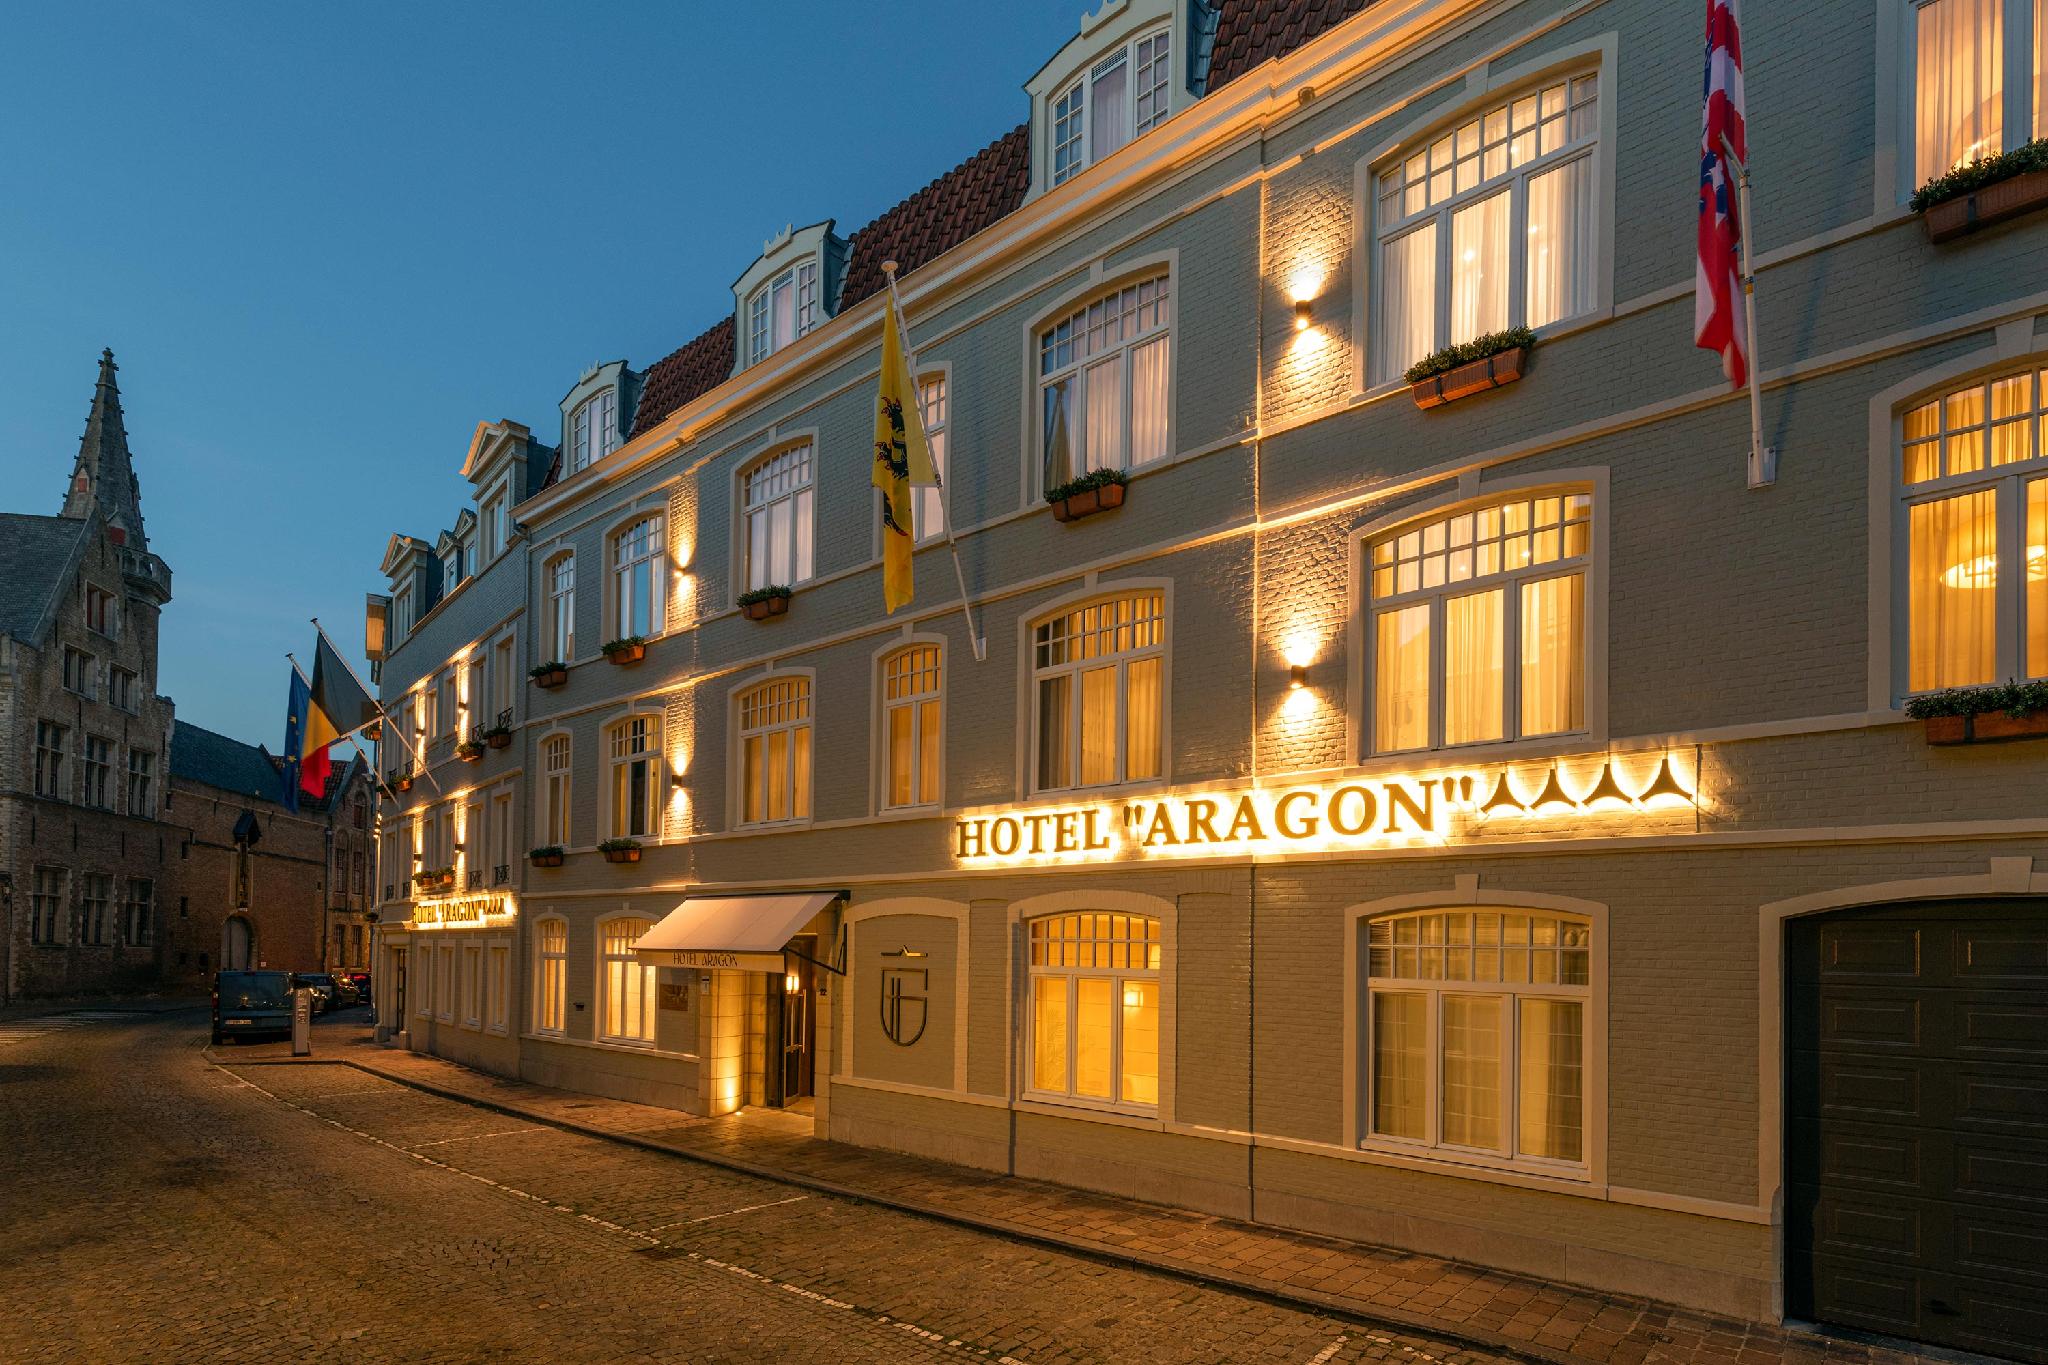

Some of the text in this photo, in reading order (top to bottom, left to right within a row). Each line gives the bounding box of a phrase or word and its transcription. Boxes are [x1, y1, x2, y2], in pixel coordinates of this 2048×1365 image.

[956, 808, 1110, 858] HOTEL
[412, 904, 438, 923] HOTEL
[673, 951, 738, 967] HOTEL ARAGON
